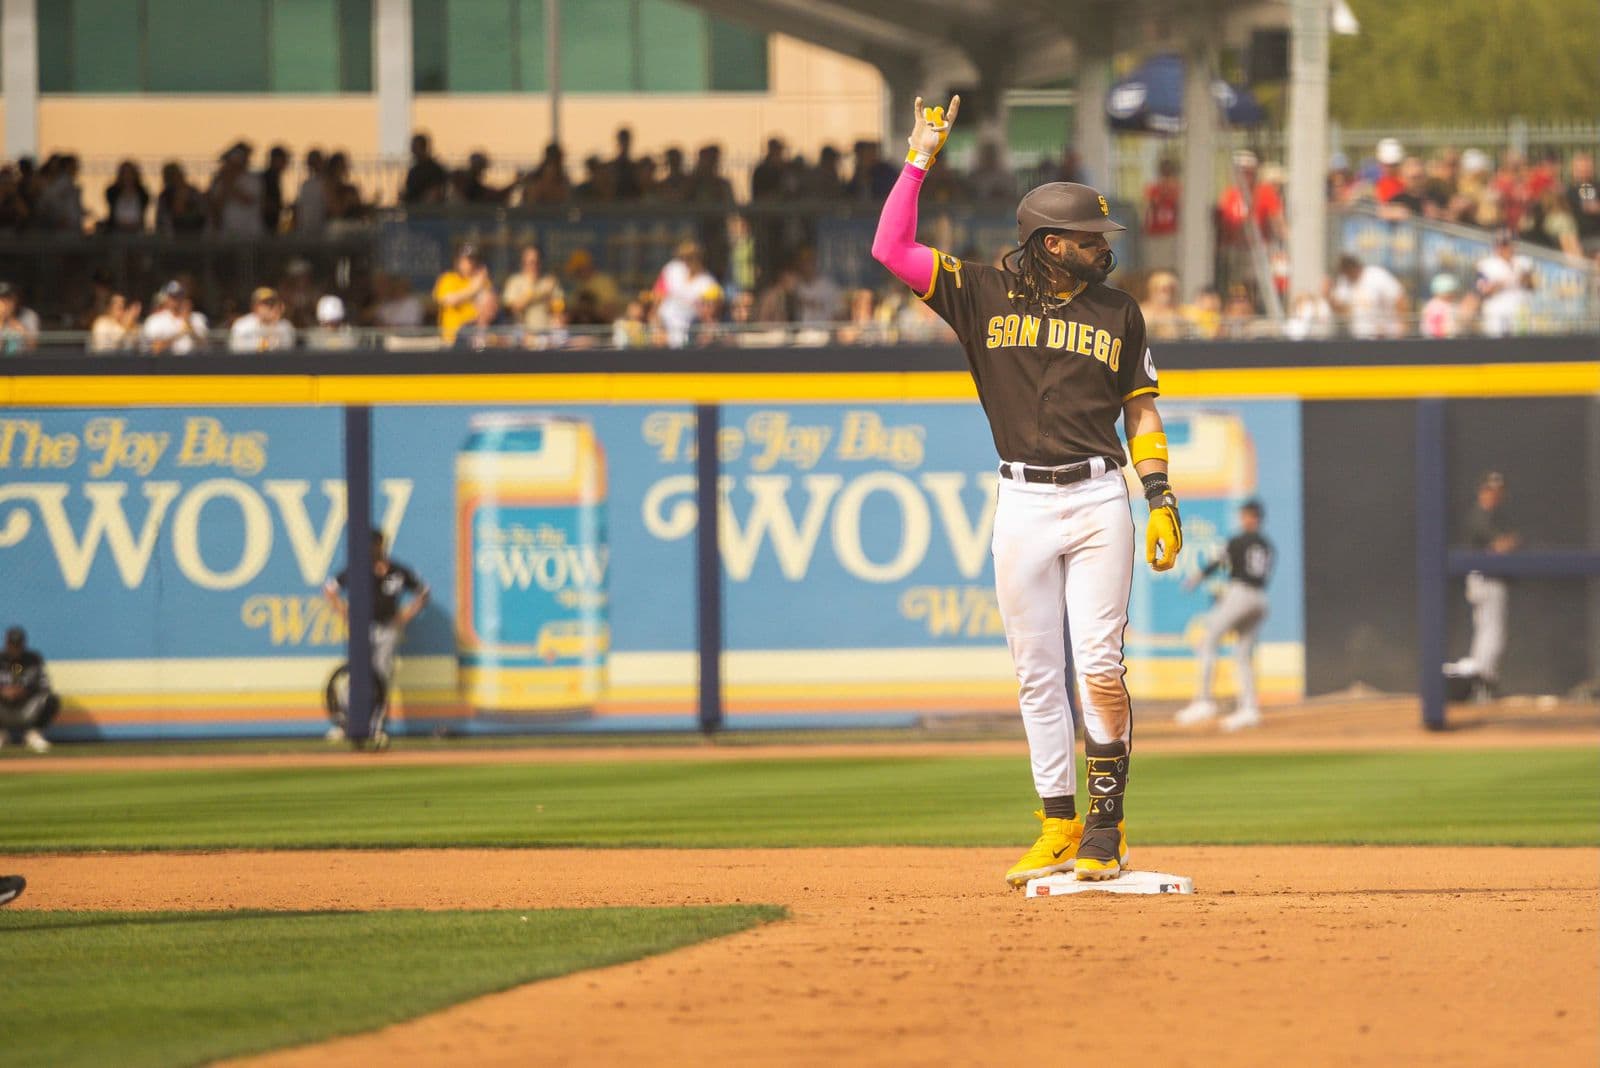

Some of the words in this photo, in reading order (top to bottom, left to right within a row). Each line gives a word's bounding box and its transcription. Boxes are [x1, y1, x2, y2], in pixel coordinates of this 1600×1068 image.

[986, 314, 1041, 349] SAN
[1046, 318, 1122, 373] DIEGO
[84, 417, 171, 478] Joy
[177, 416, 269, 477] Bus
[641, 410, 746, 465] Te
[746, 410, 832, 472] Joy
[837, 410, 927, 470] Bus
